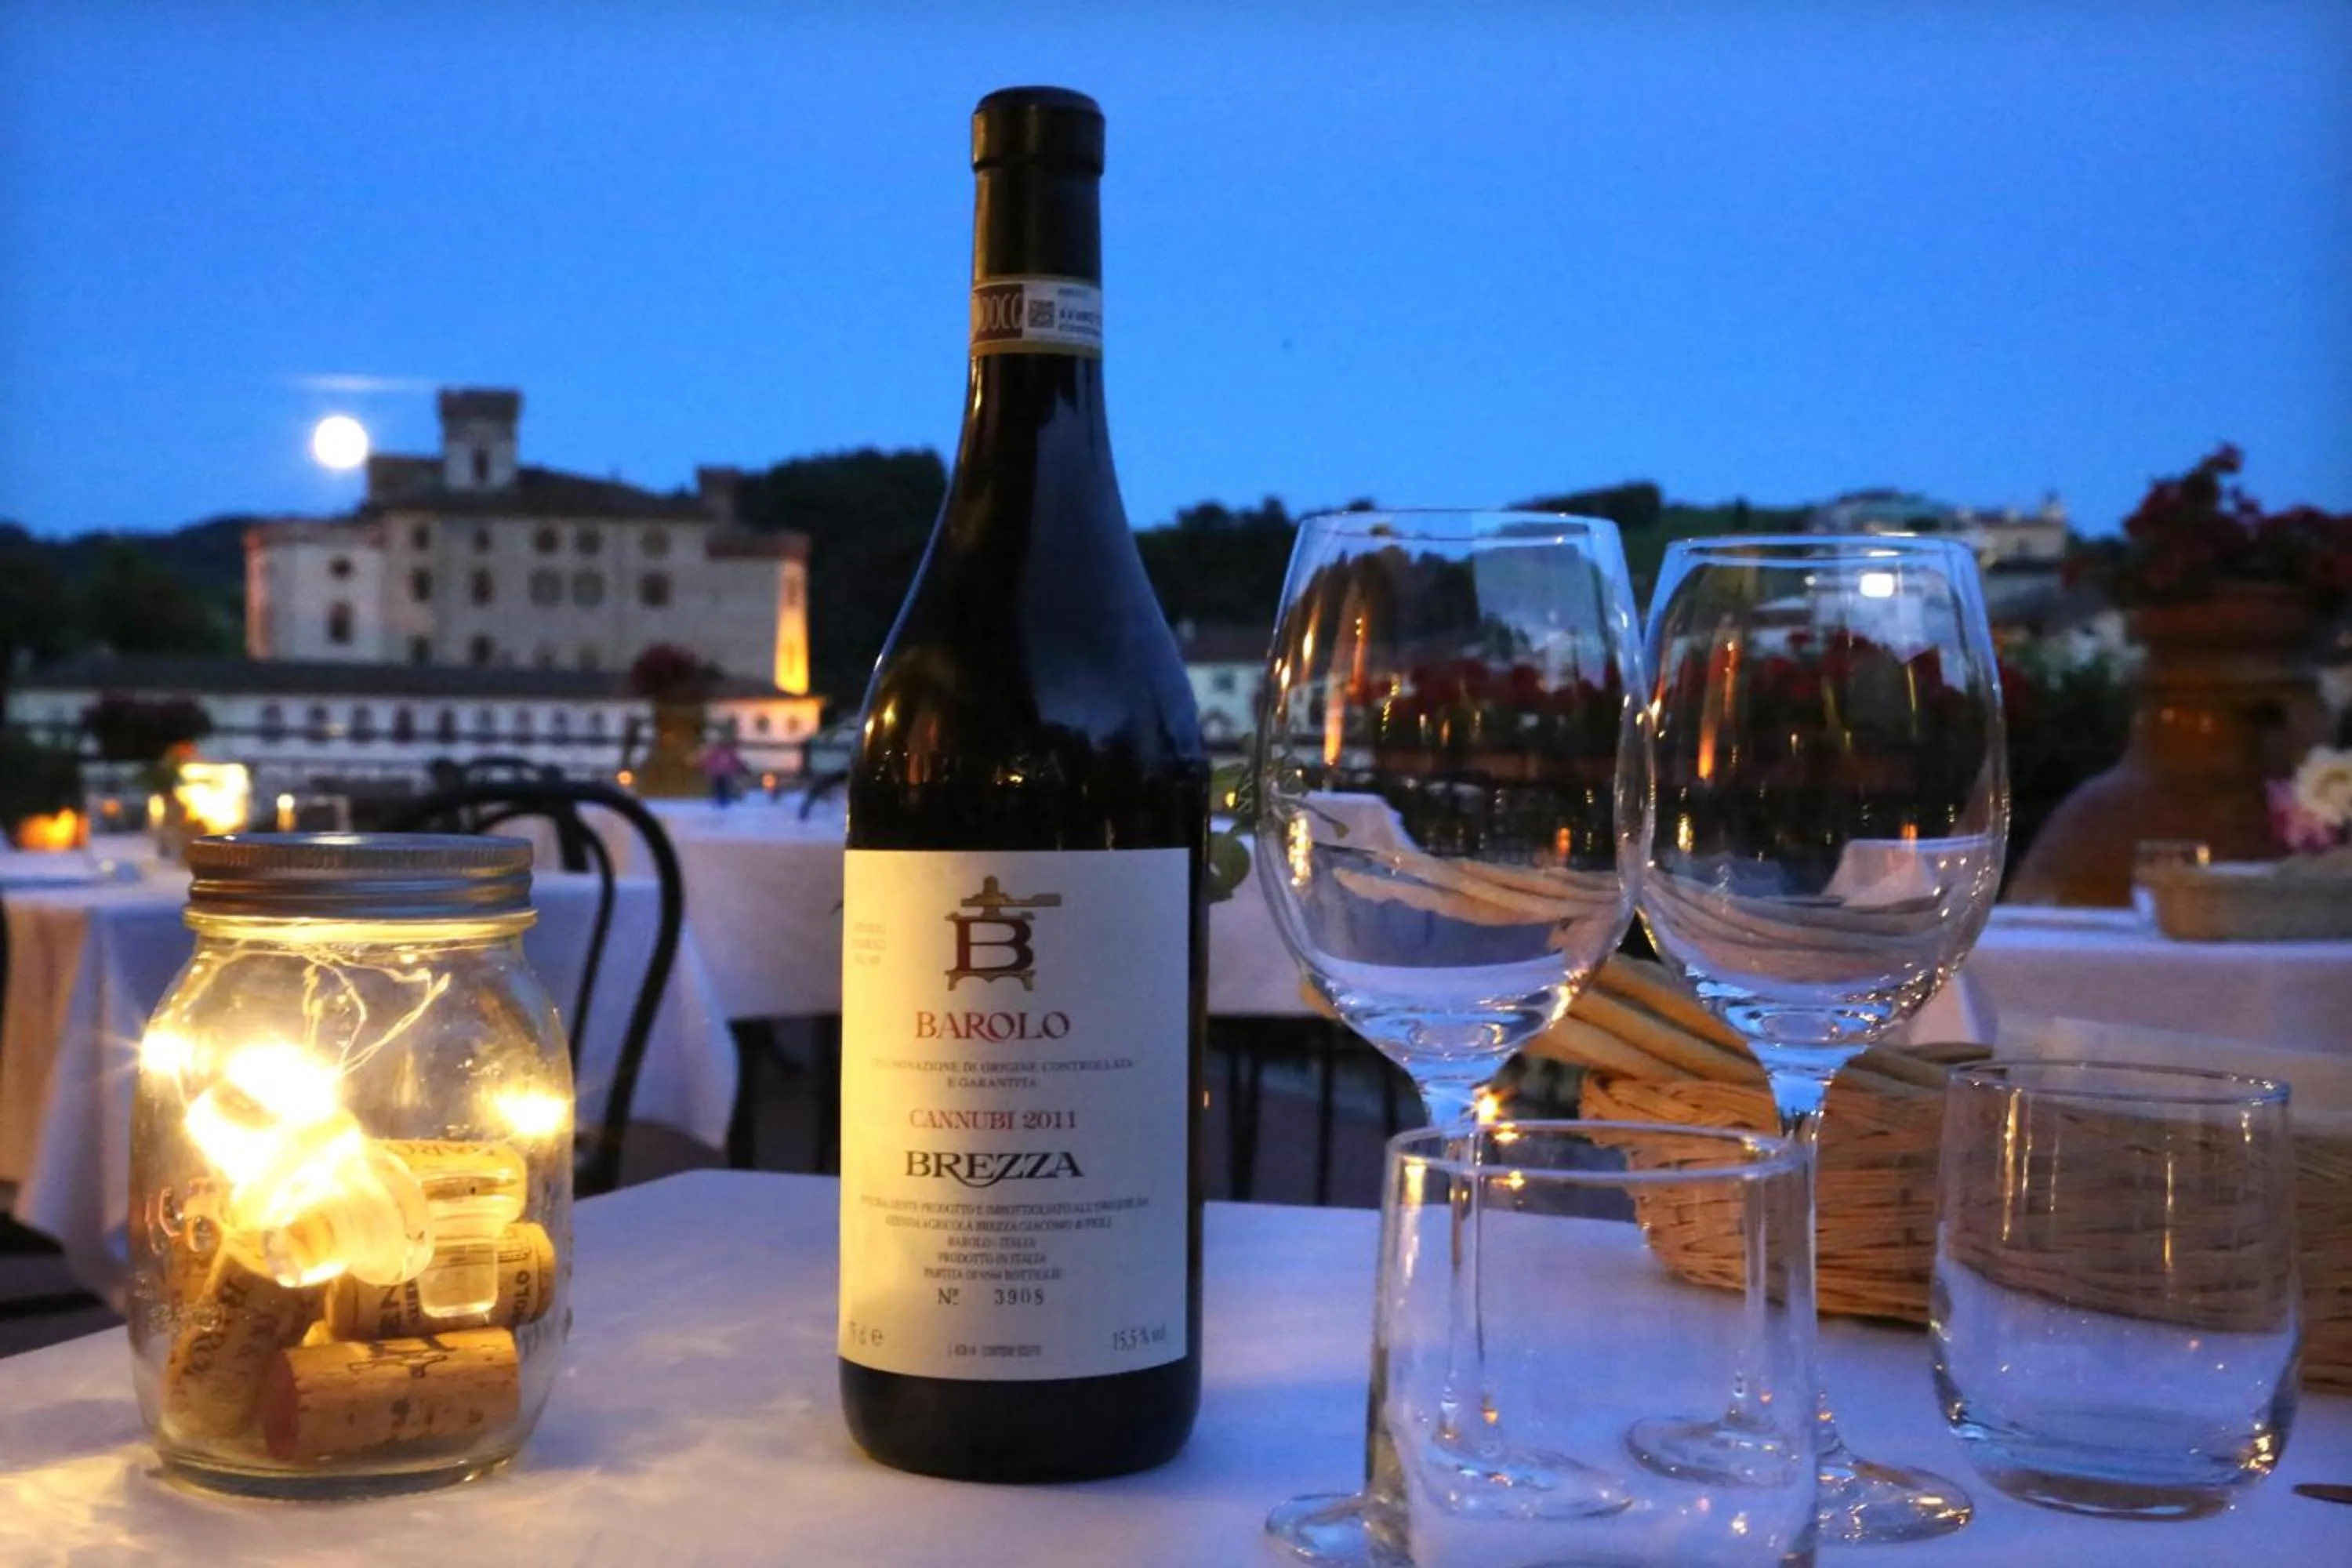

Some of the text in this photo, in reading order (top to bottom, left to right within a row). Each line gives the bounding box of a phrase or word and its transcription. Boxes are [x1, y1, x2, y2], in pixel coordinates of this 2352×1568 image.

[915, 1011, 1071, 1044] BAROLO
[909, 1109, 1077, 1131] CANNUBI 2011
[905, 1150, 1085, 1189] BREZZA
